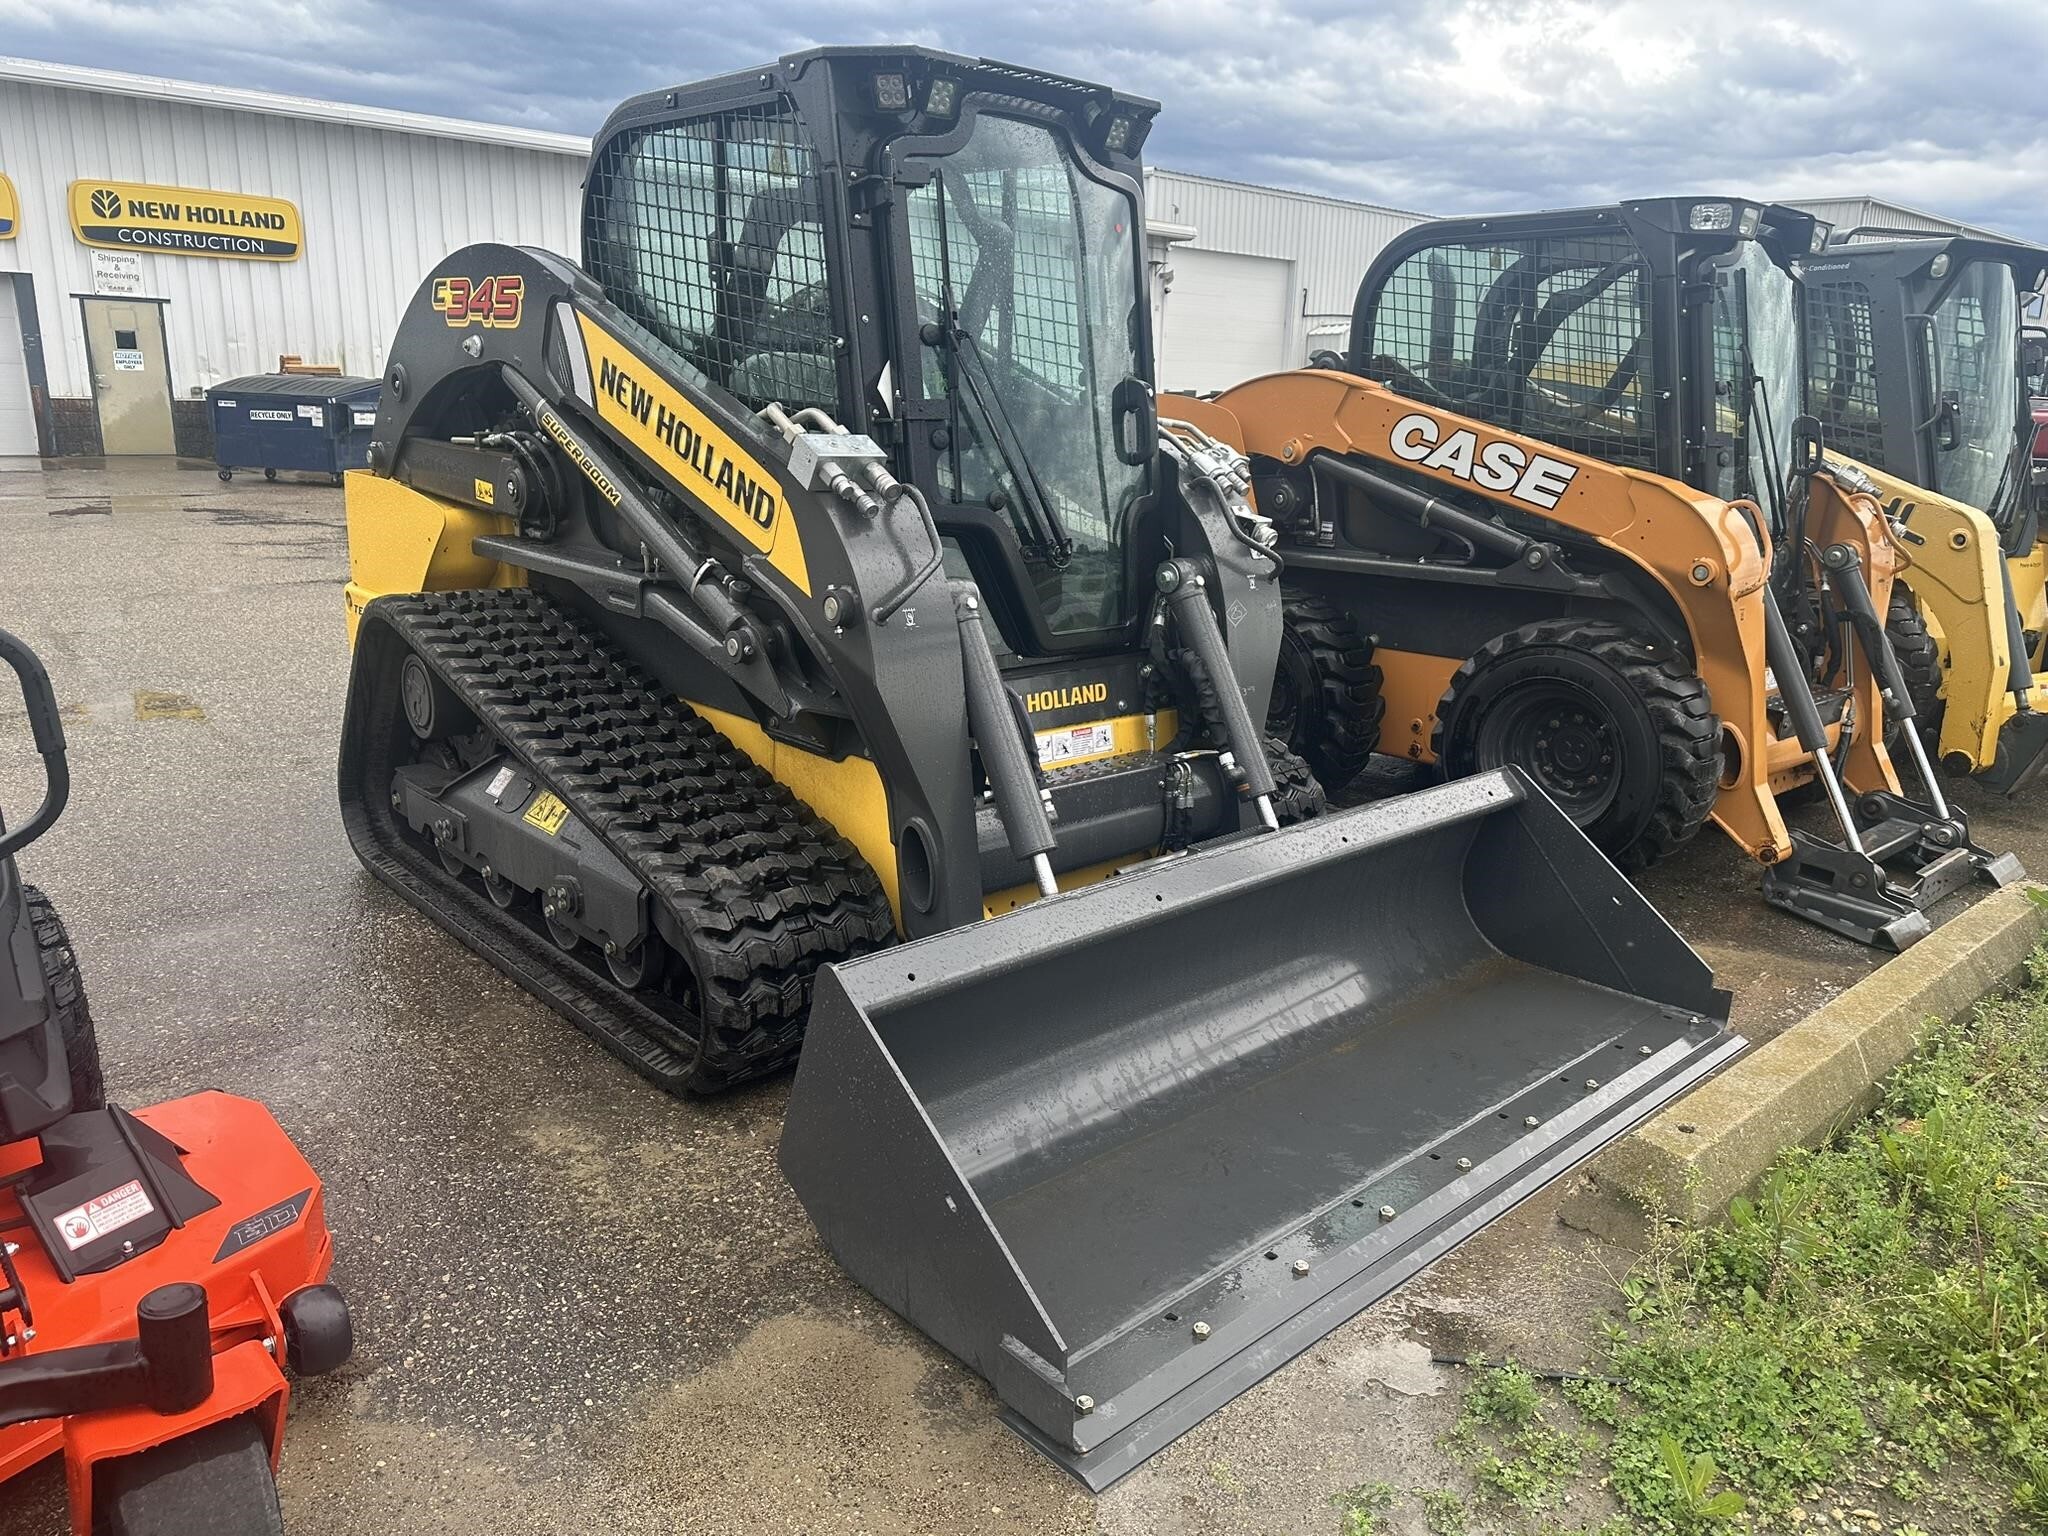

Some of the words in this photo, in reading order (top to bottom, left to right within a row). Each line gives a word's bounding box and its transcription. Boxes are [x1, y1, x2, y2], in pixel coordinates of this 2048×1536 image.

[128, 200, 180, 221] NEW
[186, 205, 285, 230] HOLLAND
[118, 229, 265, 253] CONSTRUCTION
[97, 253, 135, 264] Shipping
[96, 270, 140, 281] Receiving
[251, 410, 275, 419] RECYCLE
[600, 356, 653, 427] NEW
[655, 404, 775, 530] HOLLAND
[542, 412, 583, 464] SUPER
[581, 457, 621, 506] BOOM
[1389, 413, 1580, 511] CASE
[1027, 683, 1107, 713] HOLLAND
[101, 1183, 140, 1207] DANGER
